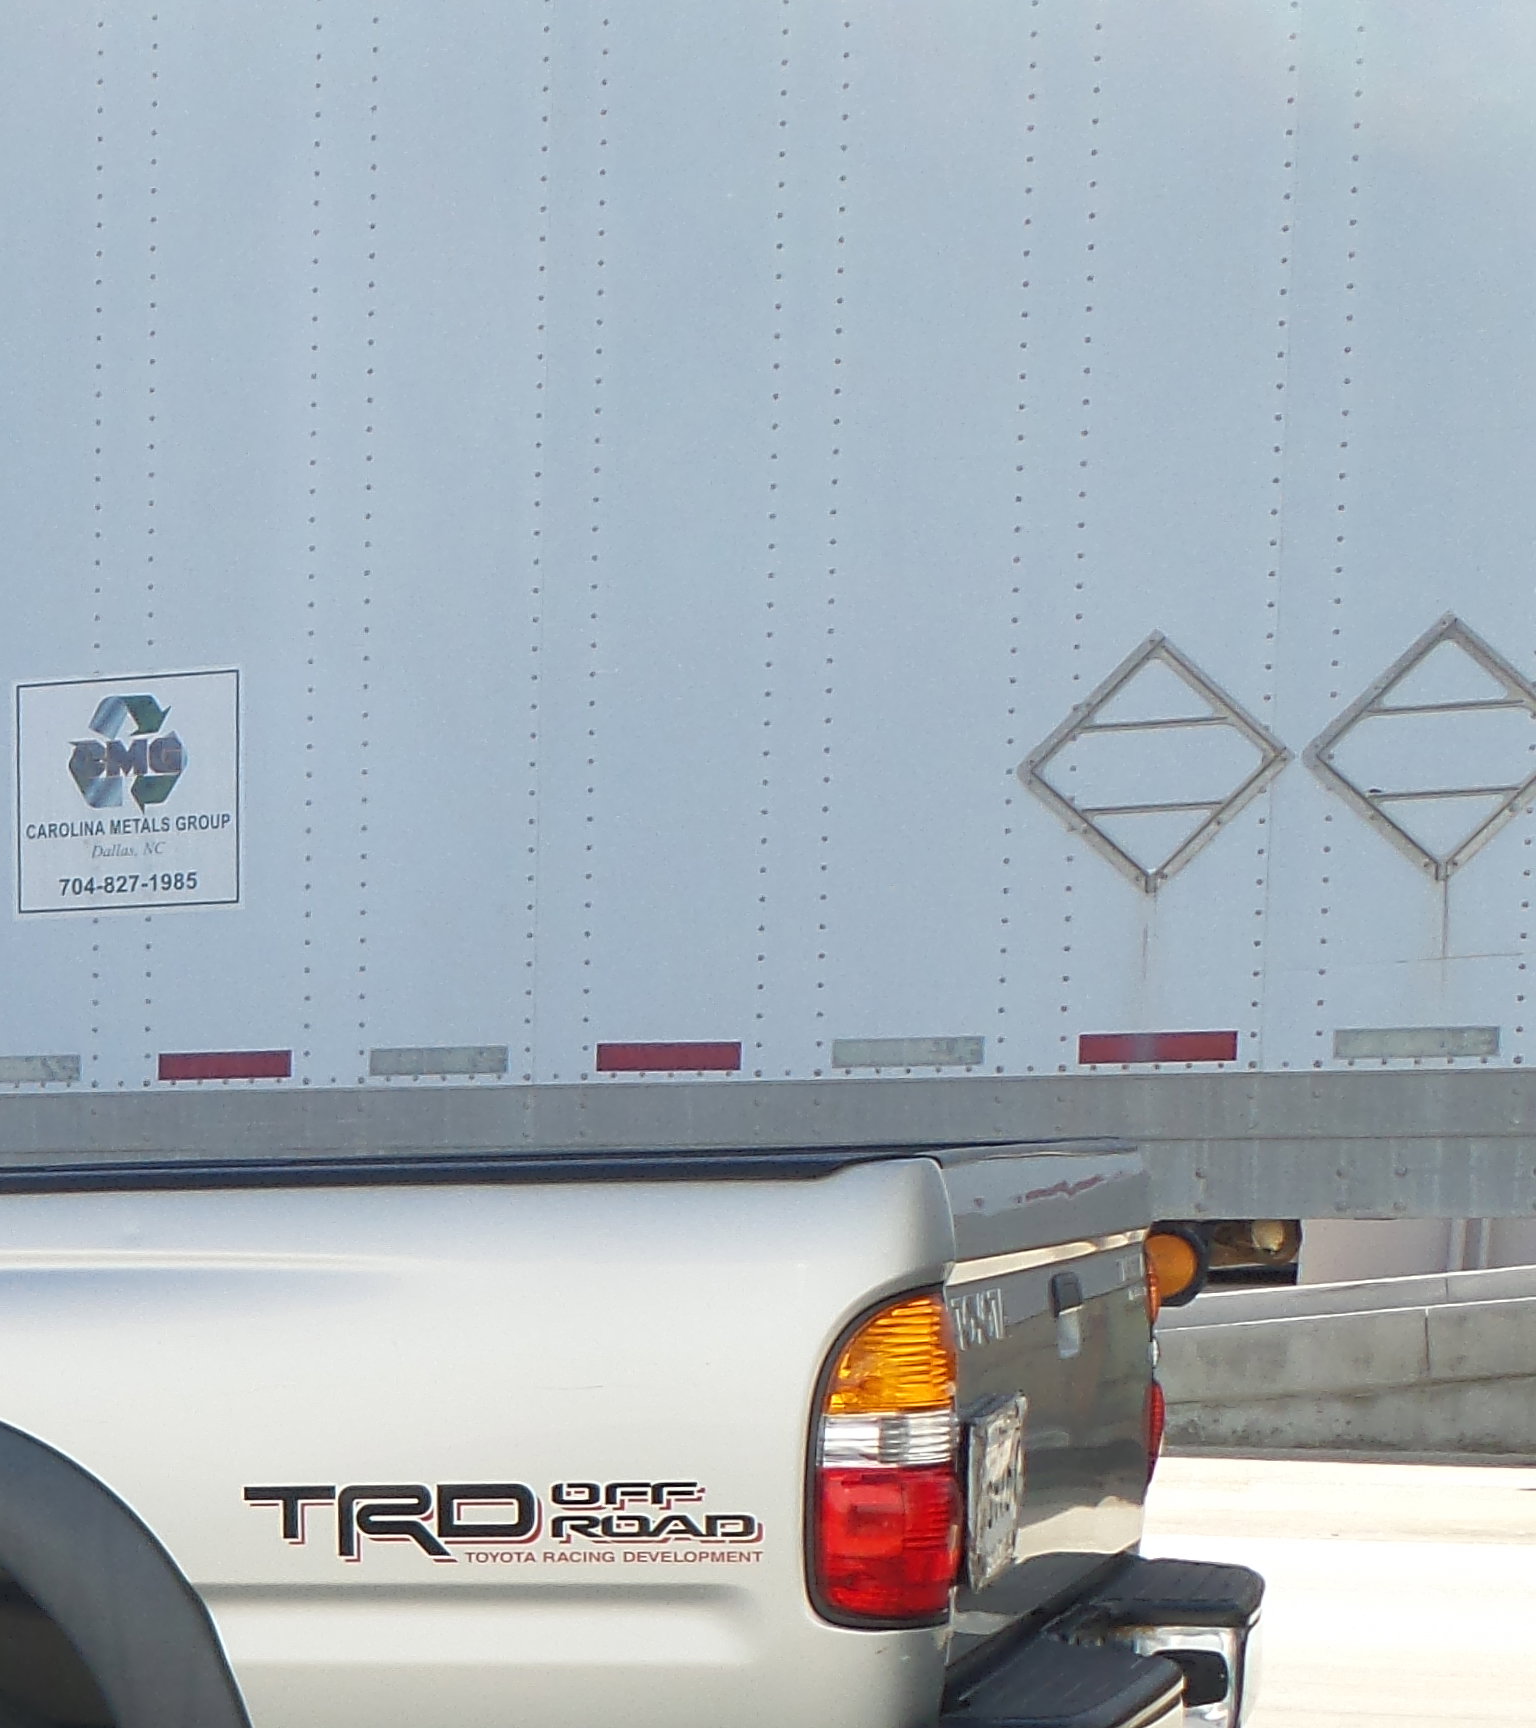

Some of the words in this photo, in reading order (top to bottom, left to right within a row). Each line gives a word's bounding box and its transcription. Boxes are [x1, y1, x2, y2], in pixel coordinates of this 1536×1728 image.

[26, 820, 105, 840] CAROLINA
[110, 816, 170, 836] METALS
[176, 813, 230, 831] GROUP
[143, 841, 166, 855] NC
[59, 872, 197, 896] 704-827-1985
[550, 1481, 705, 1510] OFF
[244, 1482, 542, 1563] TRD
[550, 1514, 764, 1543] ROAD
[465, 1550, 536, 1564] TOYOTA
[542, 1550, 615, 1564] RACING
[623, 1549, 764, 1563] DEVELOPMENT
